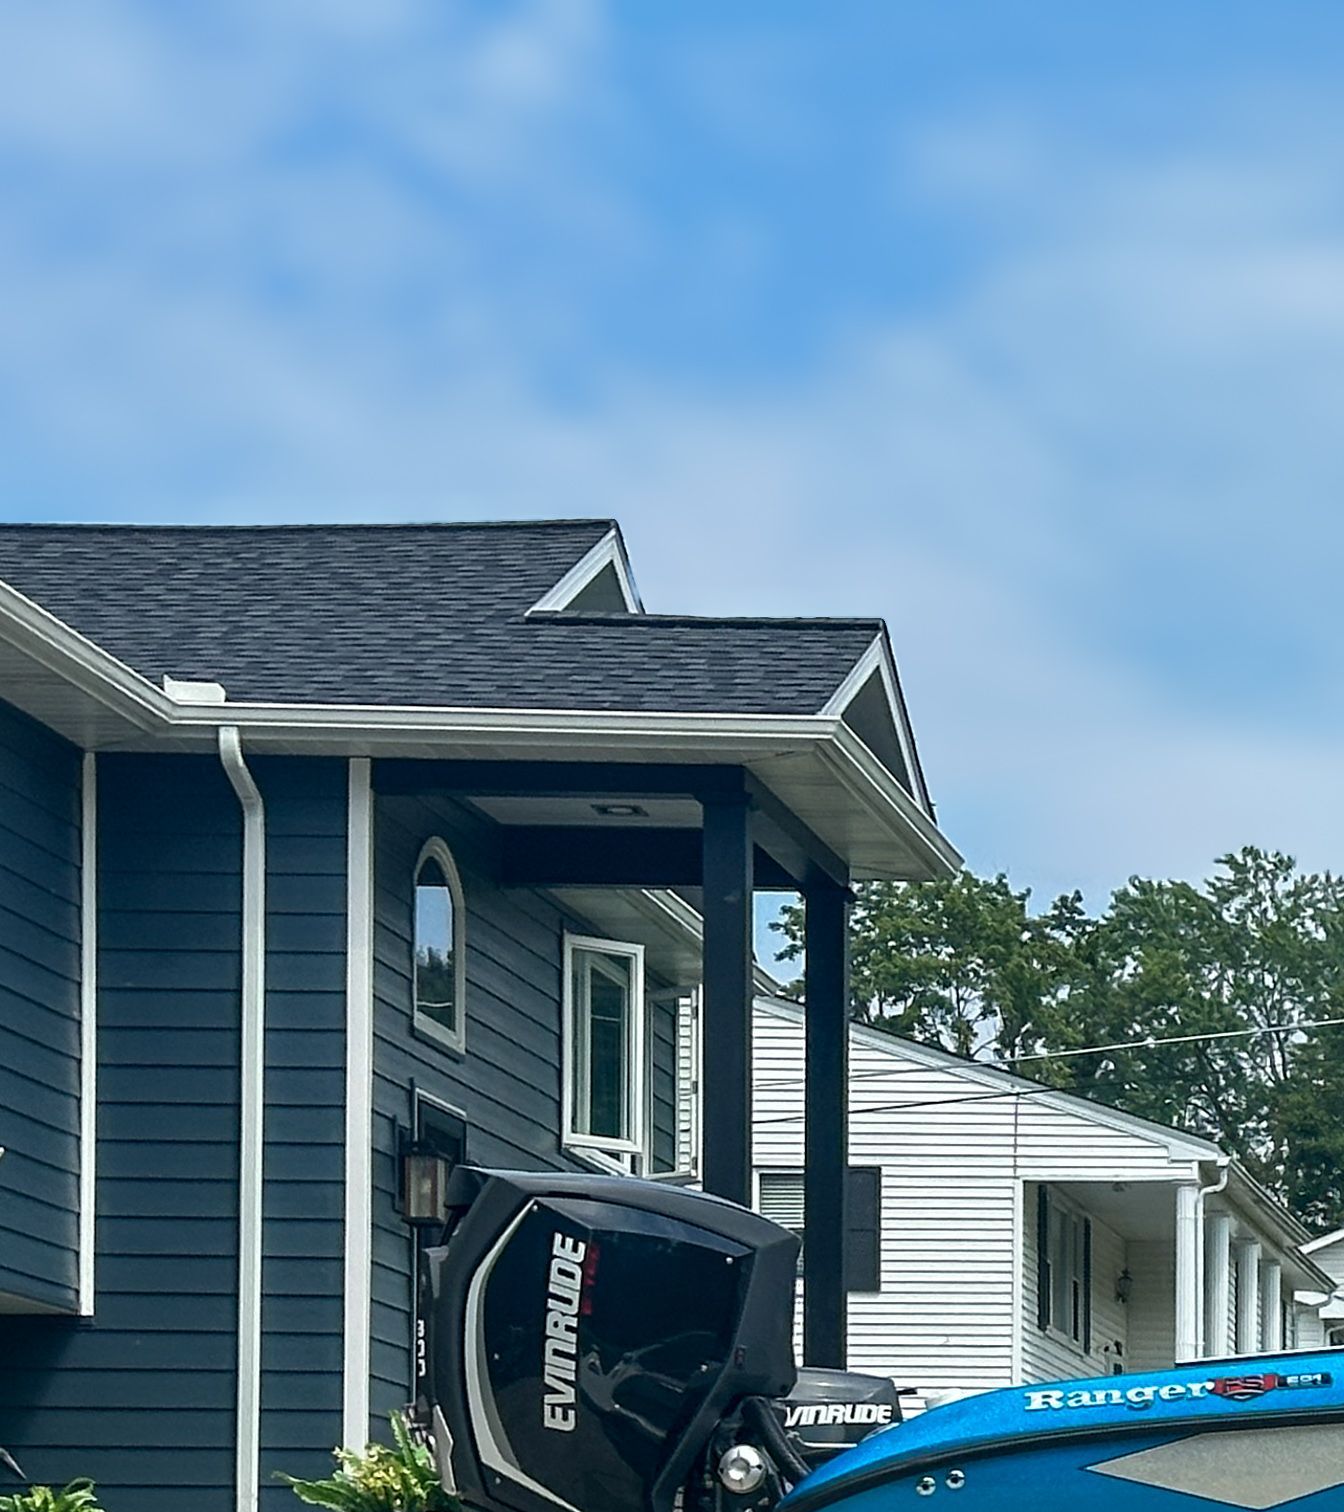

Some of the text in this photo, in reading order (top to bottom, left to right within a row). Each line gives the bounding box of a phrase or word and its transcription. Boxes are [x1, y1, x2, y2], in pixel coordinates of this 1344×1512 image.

[544, 1232, 586, 1431] EVINRUDE
[1024, 1381, 1215, 1412] Ranger
[784, 1404, 892, 1428] VINRUDE
